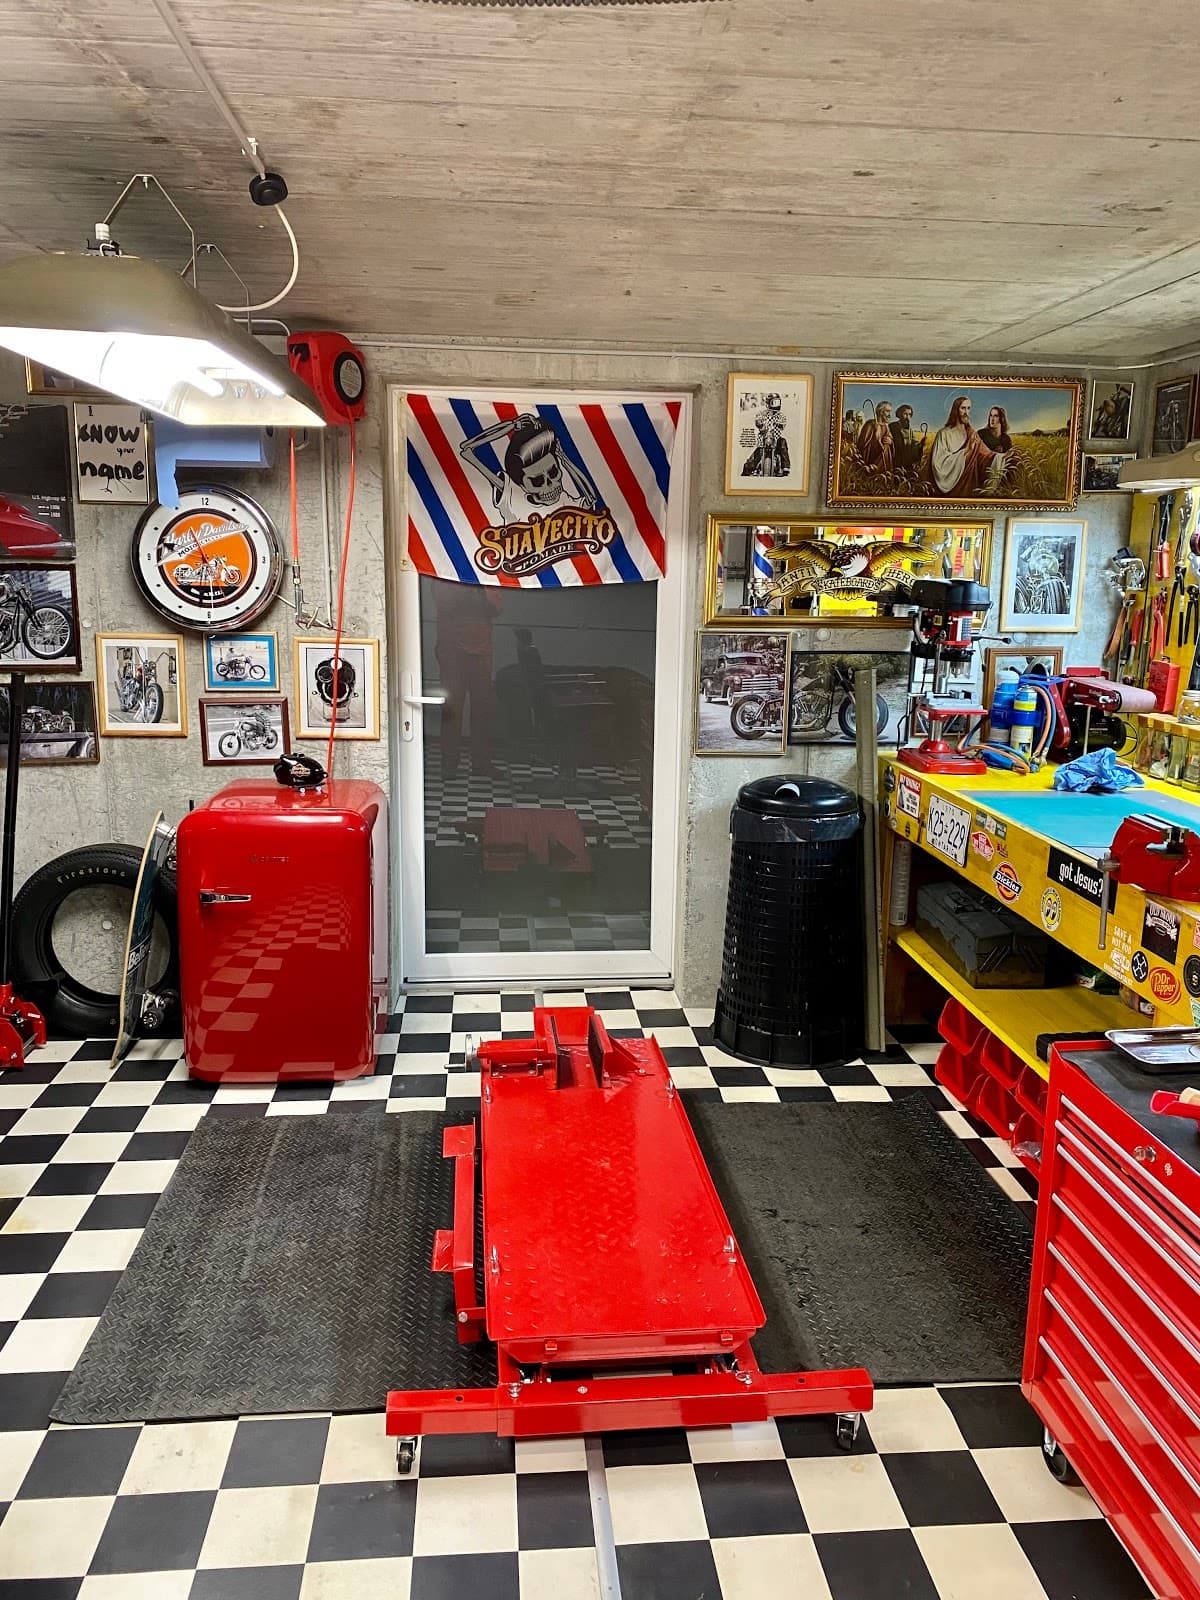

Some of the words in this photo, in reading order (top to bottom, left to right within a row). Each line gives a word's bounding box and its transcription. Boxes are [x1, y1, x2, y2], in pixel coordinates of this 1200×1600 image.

[87, 405, 94, 417] I
[116, 447, 136, 458] your
[79, 460, 145, 480] name
[201, 497, 209, 506] 12
[475, 508, 616, 571] SUAVECITO
[521, 543, 575, 570] POMADE
[781, 567, 813, 587] ANTI
[816, 577, 882, 592] SKATEBOARDS
[56, 867, 126, 884] Firestone
[995, 872, 1020, 893] Dickies
[1058, 862, 1074, 882] got
[1073, 866, 1104, 898] Jesus?
[1151, 972, 1176, 996] Pepper
[1161, 972, 1171, 985] Dr
